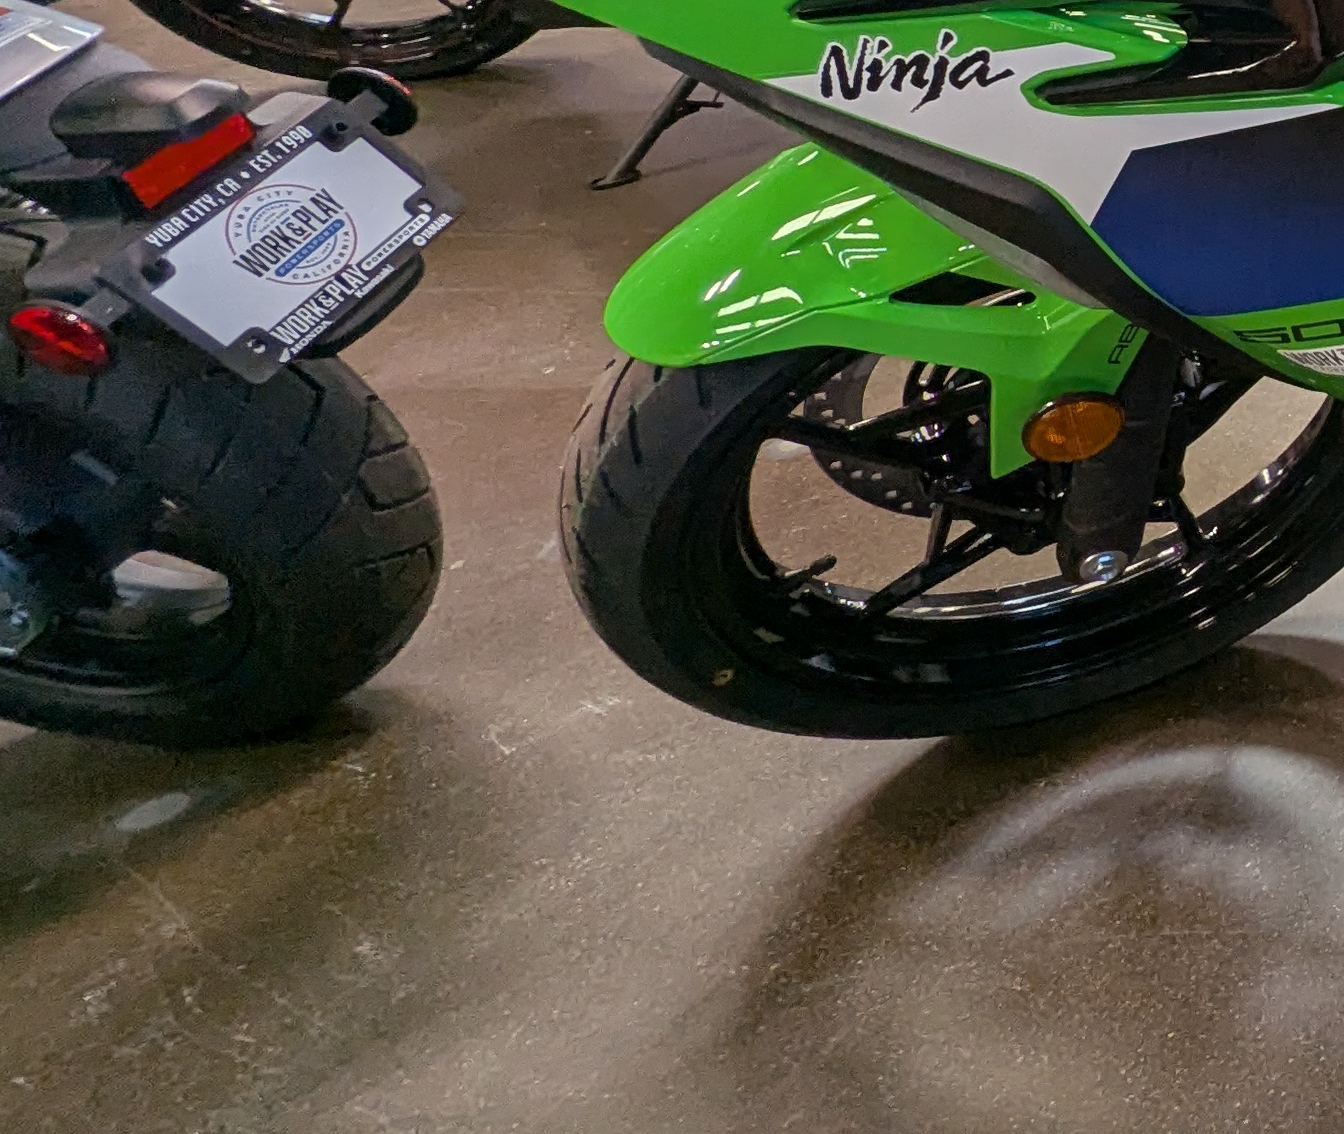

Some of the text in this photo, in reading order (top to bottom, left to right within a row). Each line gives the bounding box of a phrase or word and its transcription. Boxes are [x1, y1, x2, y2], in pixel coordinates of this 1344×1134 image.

[820, 31, 1015, 114] Ninja
[144, 215, 191, 248] YUBA
[181, 193, 227, 223] CITY,
[216, 177, 242, 198] CA
[249, 149, 283, 174] EST.
[234, 206, 252, 238] YUBA
[256, 190, 294, 202] CITY
[279, 222, 341, 276] POWERSPORTS
[292, 230, 350, 280] CALIFORNIA
[365, 217, 426, 267] POWERSPORTS
[289, 320, 334, 354] HONDA
[1107, 324, 1140, 364] AB
